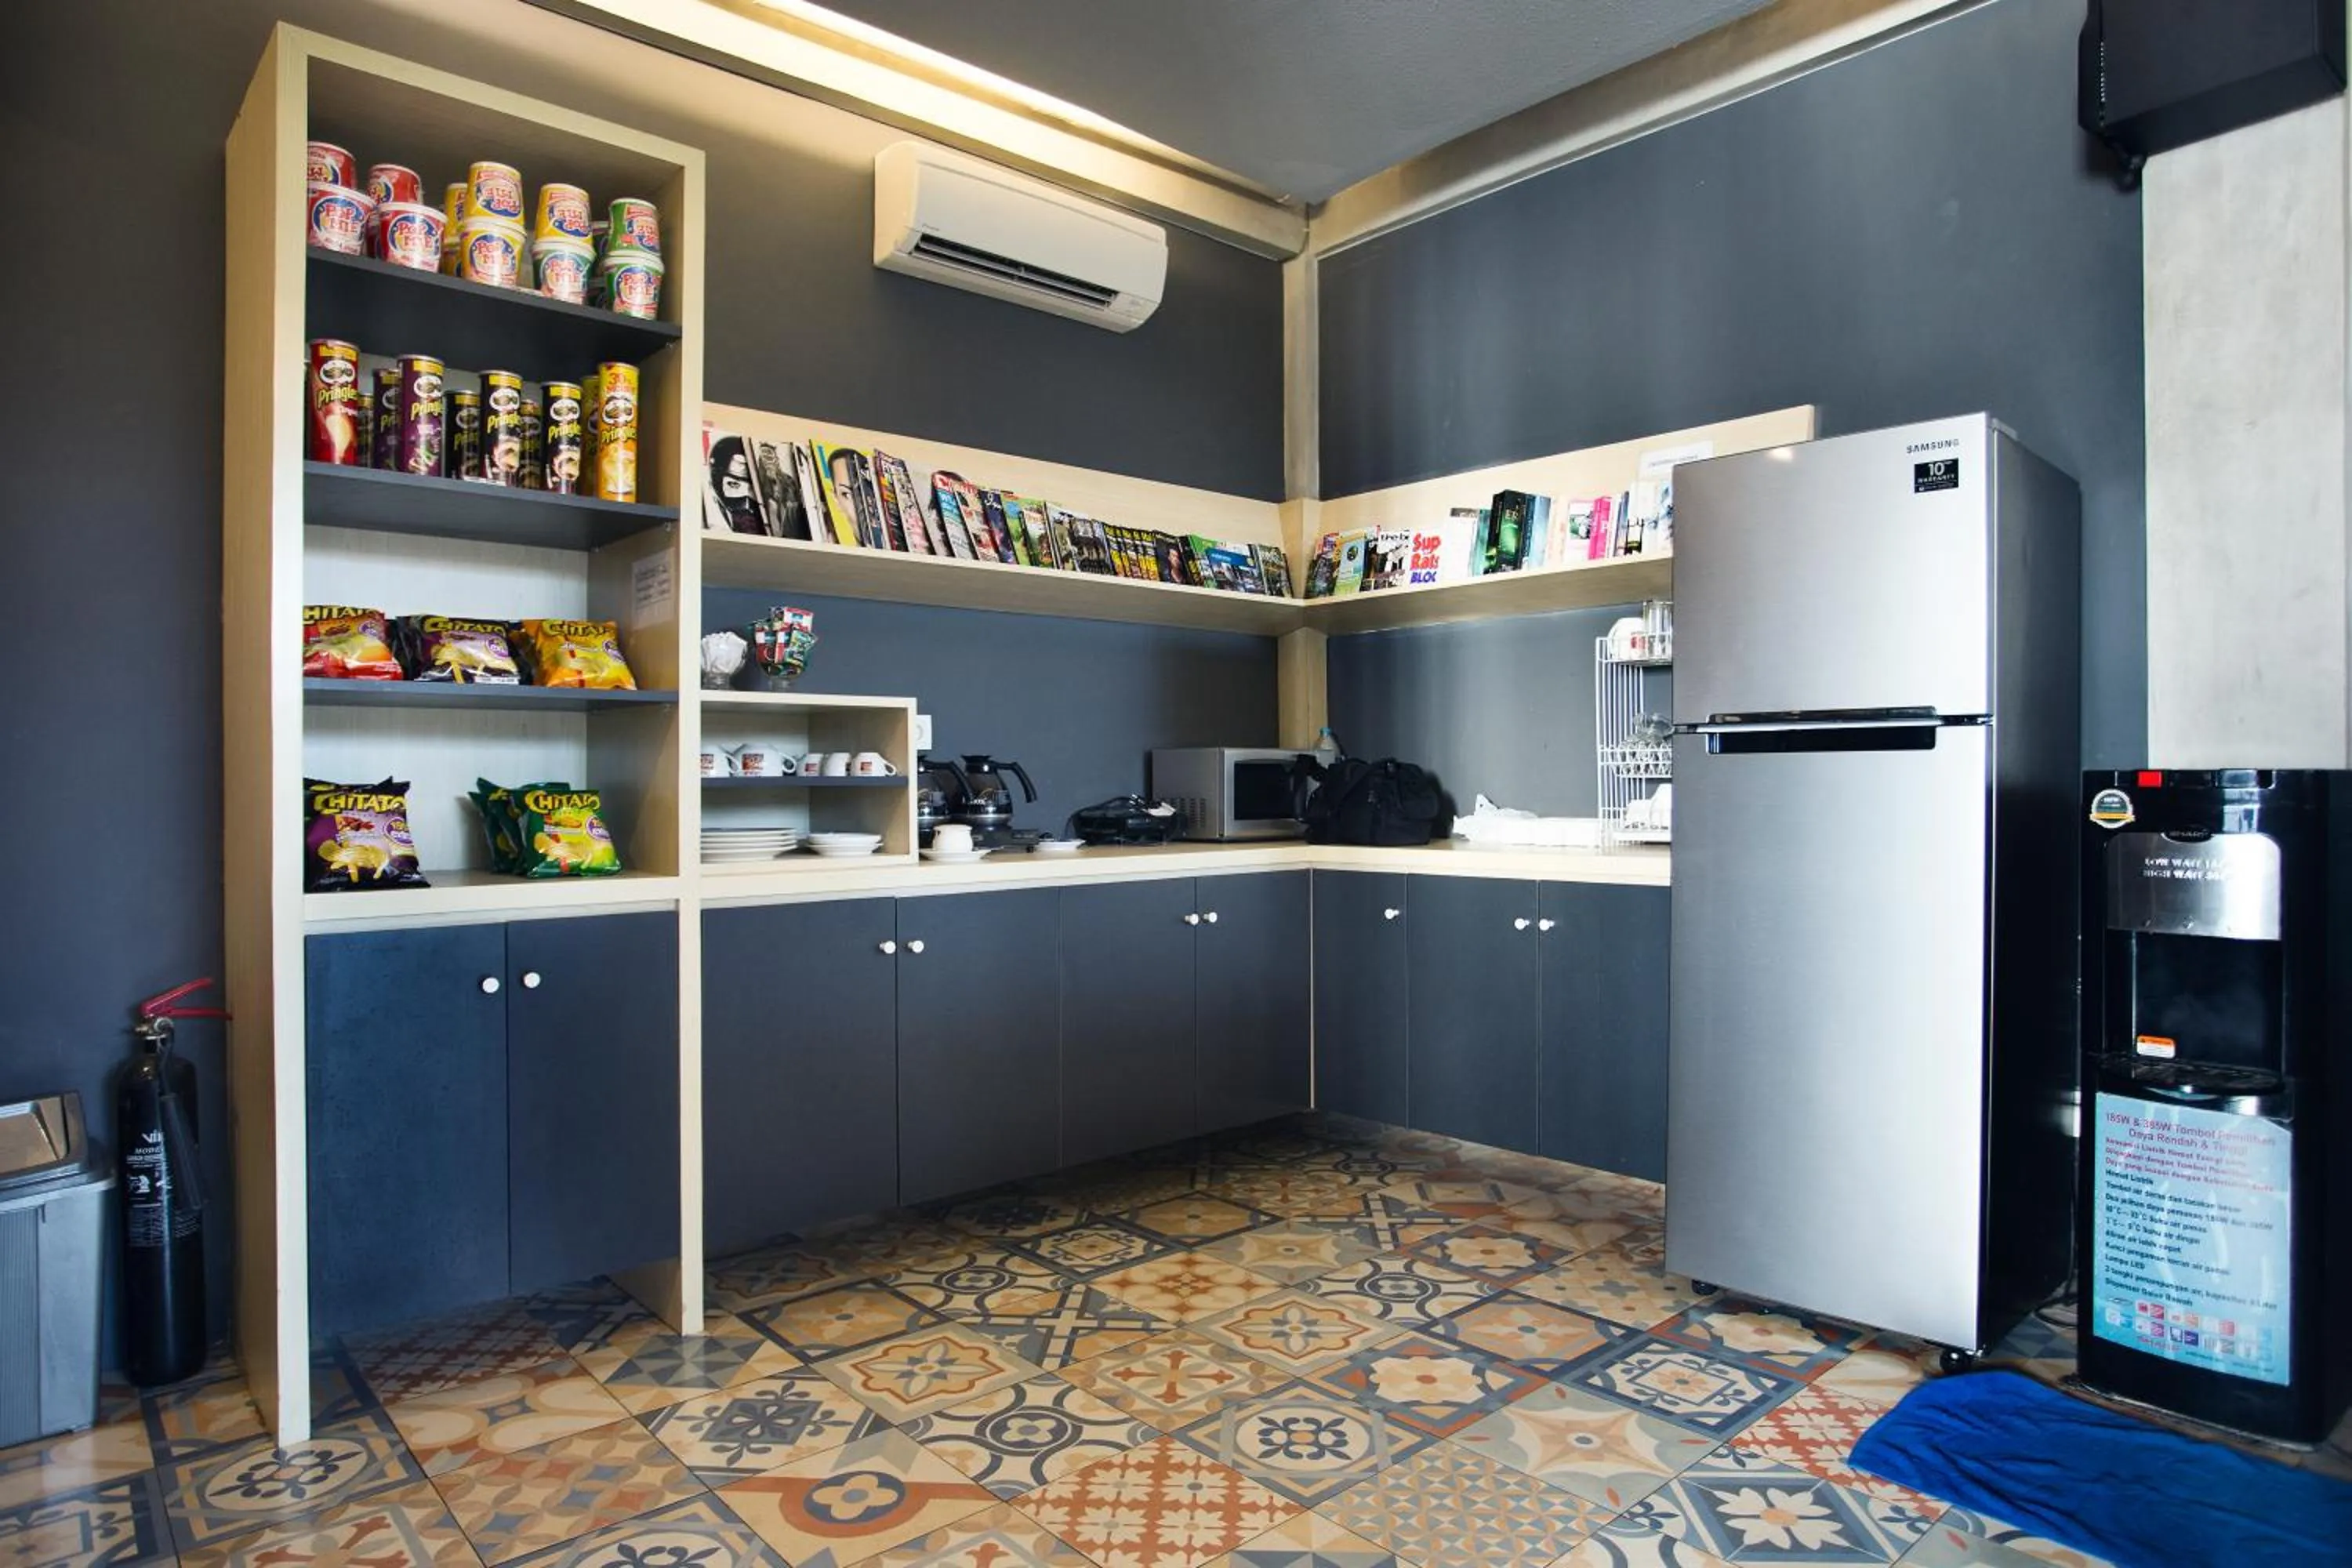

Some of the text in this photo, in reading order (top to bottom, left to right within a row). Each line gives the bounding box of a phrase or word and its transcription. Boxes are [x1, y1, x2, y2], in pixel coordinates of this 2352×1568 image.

[1906, 439, 1959, 454] SAMSUNG
[314, 793, 407, 815] CHITATO
[524, 789, 601, 815] CHITATO
[2129, 1128, 2154, 1142] Daya
